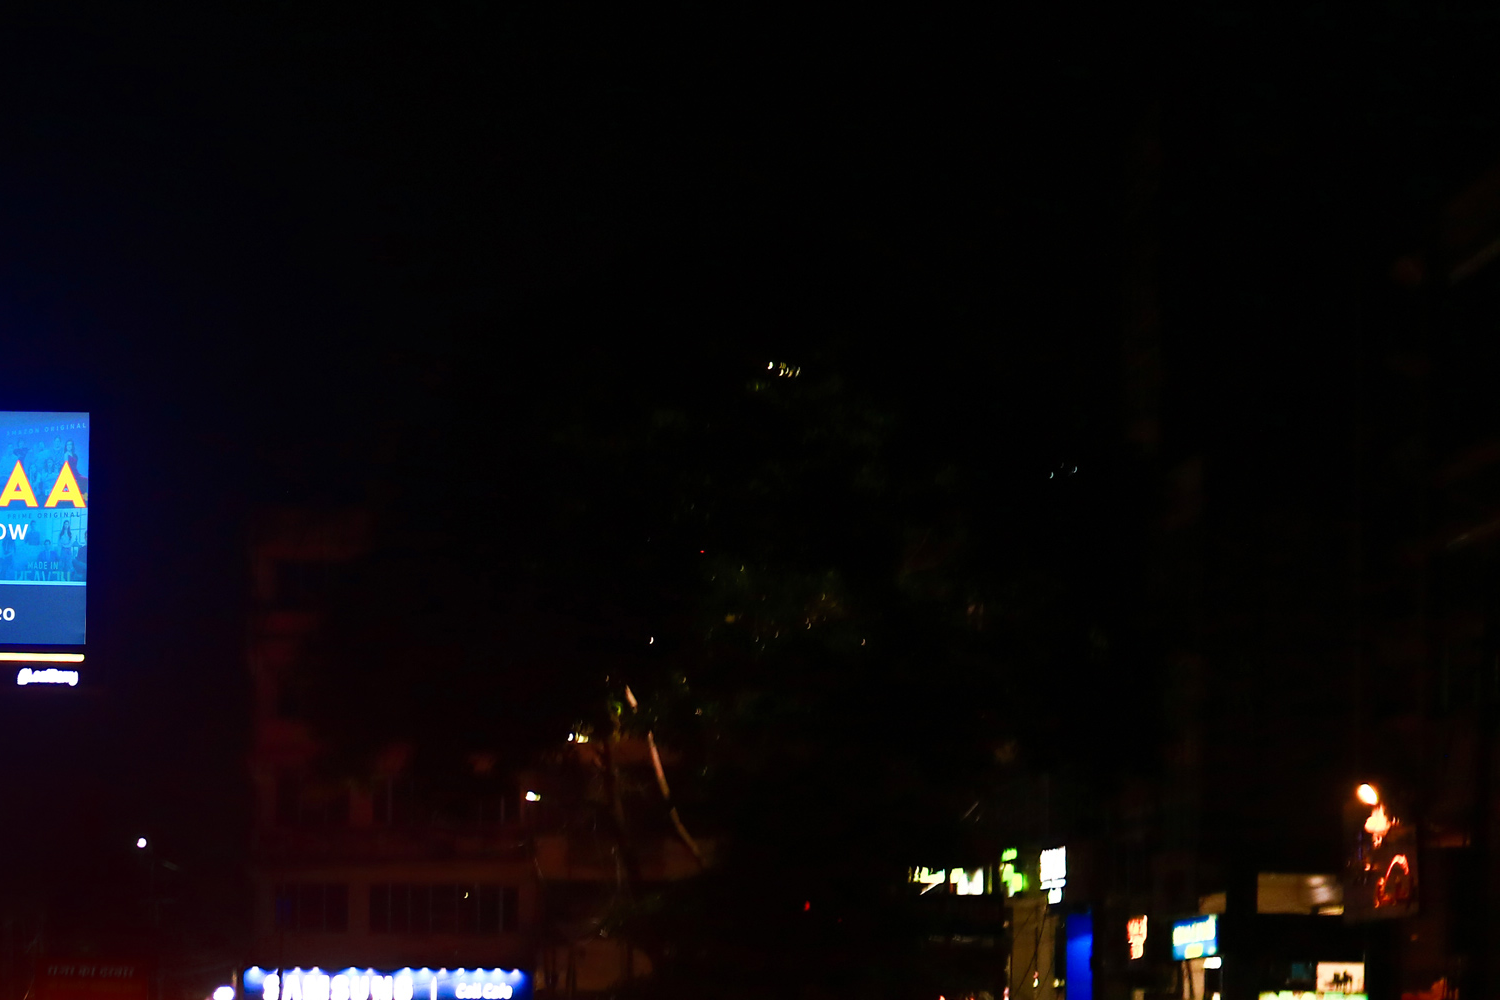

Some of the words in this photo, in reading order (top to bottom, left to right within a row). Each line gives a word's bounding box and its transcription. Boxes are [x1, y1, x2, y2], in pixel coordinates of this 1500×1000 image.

[6, 427, 40, 436] AMAZON
[44, 422, 87, 433] ORIGINAL
[27, 561, 48, 570] MADE
[50, 561, 59, 570] IN
